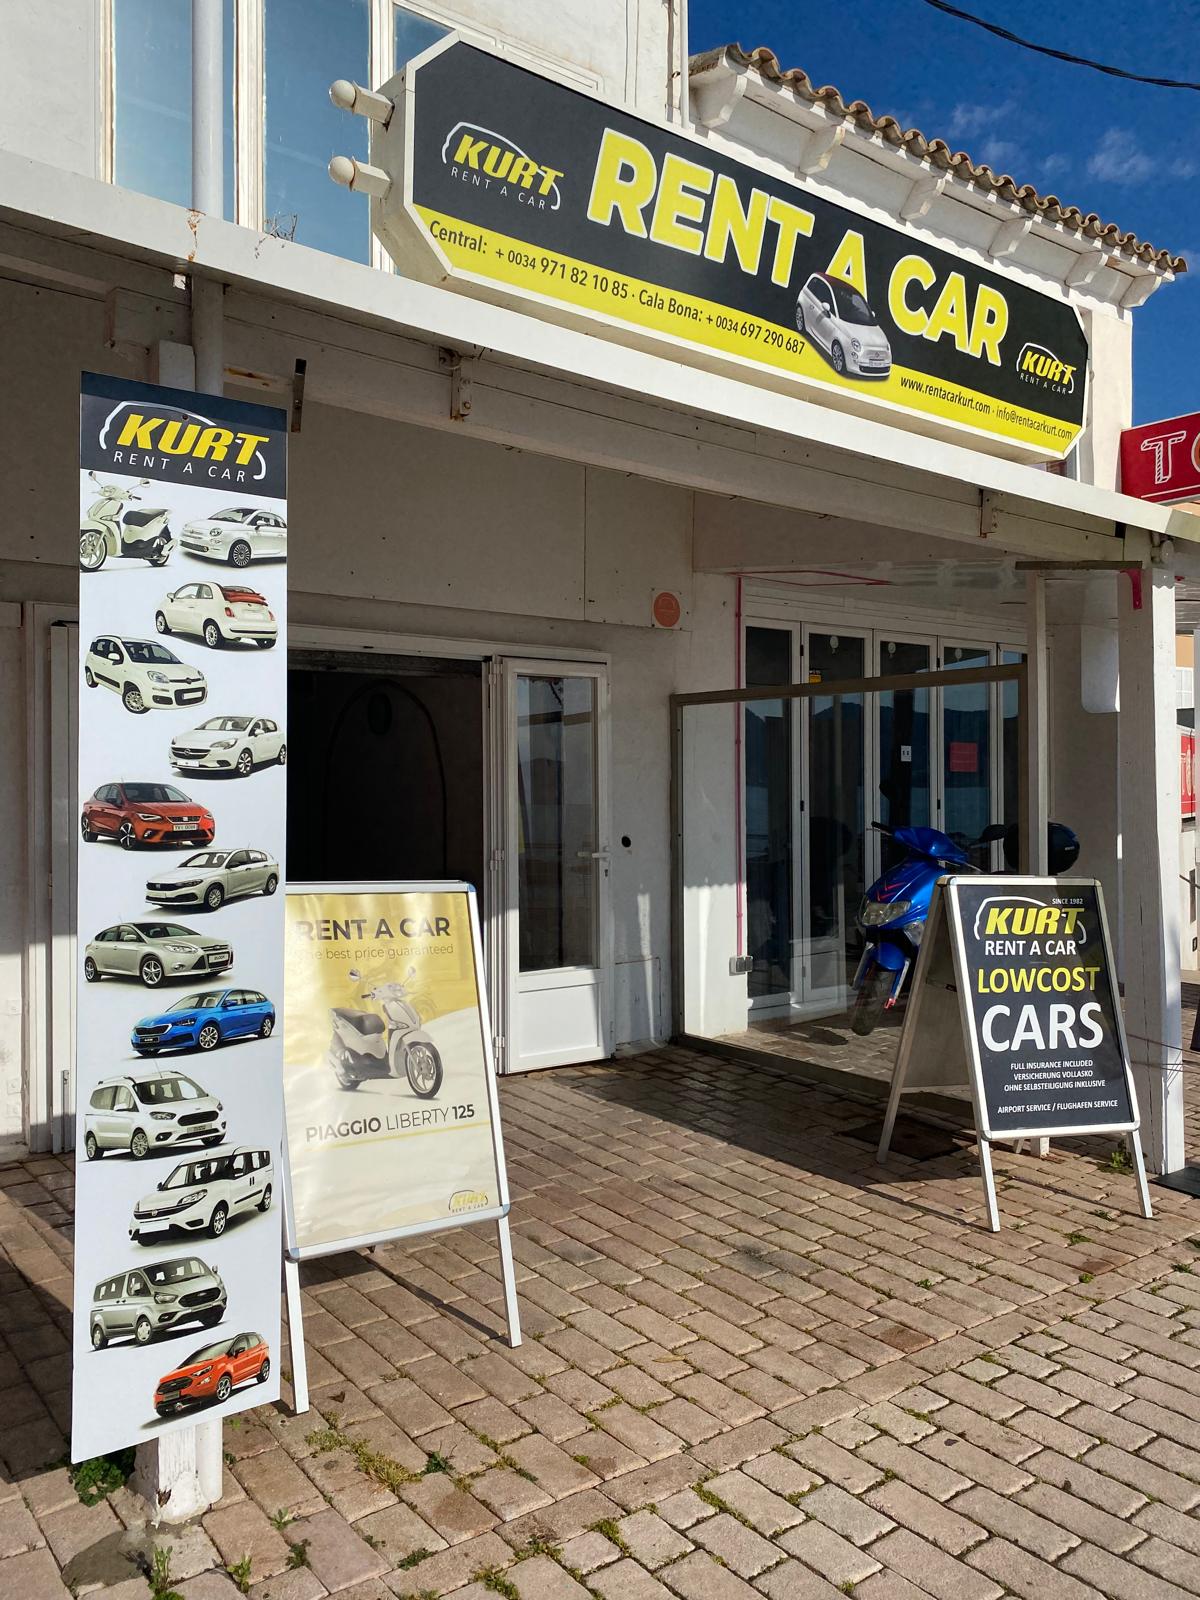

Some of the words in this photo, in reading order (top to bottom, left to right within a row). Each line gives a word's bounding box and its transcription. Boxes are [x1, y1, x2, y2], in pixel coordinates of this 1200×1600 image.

[453, 134, 565, 196] KURT
[450, 166, 491, 190] RENT
[500, 186, 508, 197] A
[518, 192, 546, 210] CAR
[587, 127, 816, 289] RENT
[825, 229, 868, 302] A
[888, 254, 1009, 367] CAR
[429, 220, 488, 254] Central:
[508, 249, 536, 270] 0034
[540, 257, 566, 280] 971
[570, 267, 588, 287] 82
[593, 273, 609, 293] 10
[611, 280, 629, 299] 85
[638, 289, 664, 310] Cala
[667, 298, 703, 322] Bona:
[715, 315, 739, 334] 0034
[740, 321, 762, 340] 697
[763, 328, 784, 348] 290
[785, 337, 806, 355] 687
[1020, 373, 1040, 387] RENT
[1051, 383, 1067, 395] CAR
[1021, 350, 1077, 385] KURT
[900, 376, 991, 414] www.rentacarkurt.com
[996, 404, 1073, 441] info@rentacarkurt.com
[116, 413, 270, 466] KURT
[113, 450, 170, 471] RENT
[183, 462, 193, 475] A
[208, 465, 245, 483] CAR
[1141, 430, 1200, 485] T
[294, 919, 368, 941] RENT
[374, 918, 395, 939] A
[399, 916, 451, 938] CAR
[984, 907, 1085, 936] KURT
[326, 947, 351, 960] best
[355, 946, 385, 961] price
[387, 944, 454, 960] guaranteed
[984, 940, 1026, 956] RENT
[1029, 940, 1042, 956] A
[1045, 940, 1077, 955] CAR
[977, 966, 1101, 994] LOWCOST
[981, 1002, 1104, 1052] CARS
[1010, 1062, 1026, 1070] FULL
[1026, 1061, 1062, 1070] INSURANCE
[1062, 1060, 1094, 1068] INCLUDED
[1014, 1071, 1061, 1081] VERSICHERUNG
[1004, 1083, 1023, 1092] OHNE
[1074, 1079, 1106, 1088] INKLUSIVE
[305, 1117, 382, 1143] PIAGGIO
[385, 1107, 450, 1131] LIBERTY
[451, 1103, 475, 1120] 125
[997, 1105, 1025, 1114] AIRPORT
[1026, 1103, 1051, 1112] SERVICE
[1056, 1101, 1093, 1110] FLUGHAFEN
[1094, 1099, 1119, 1109] SERVICE
